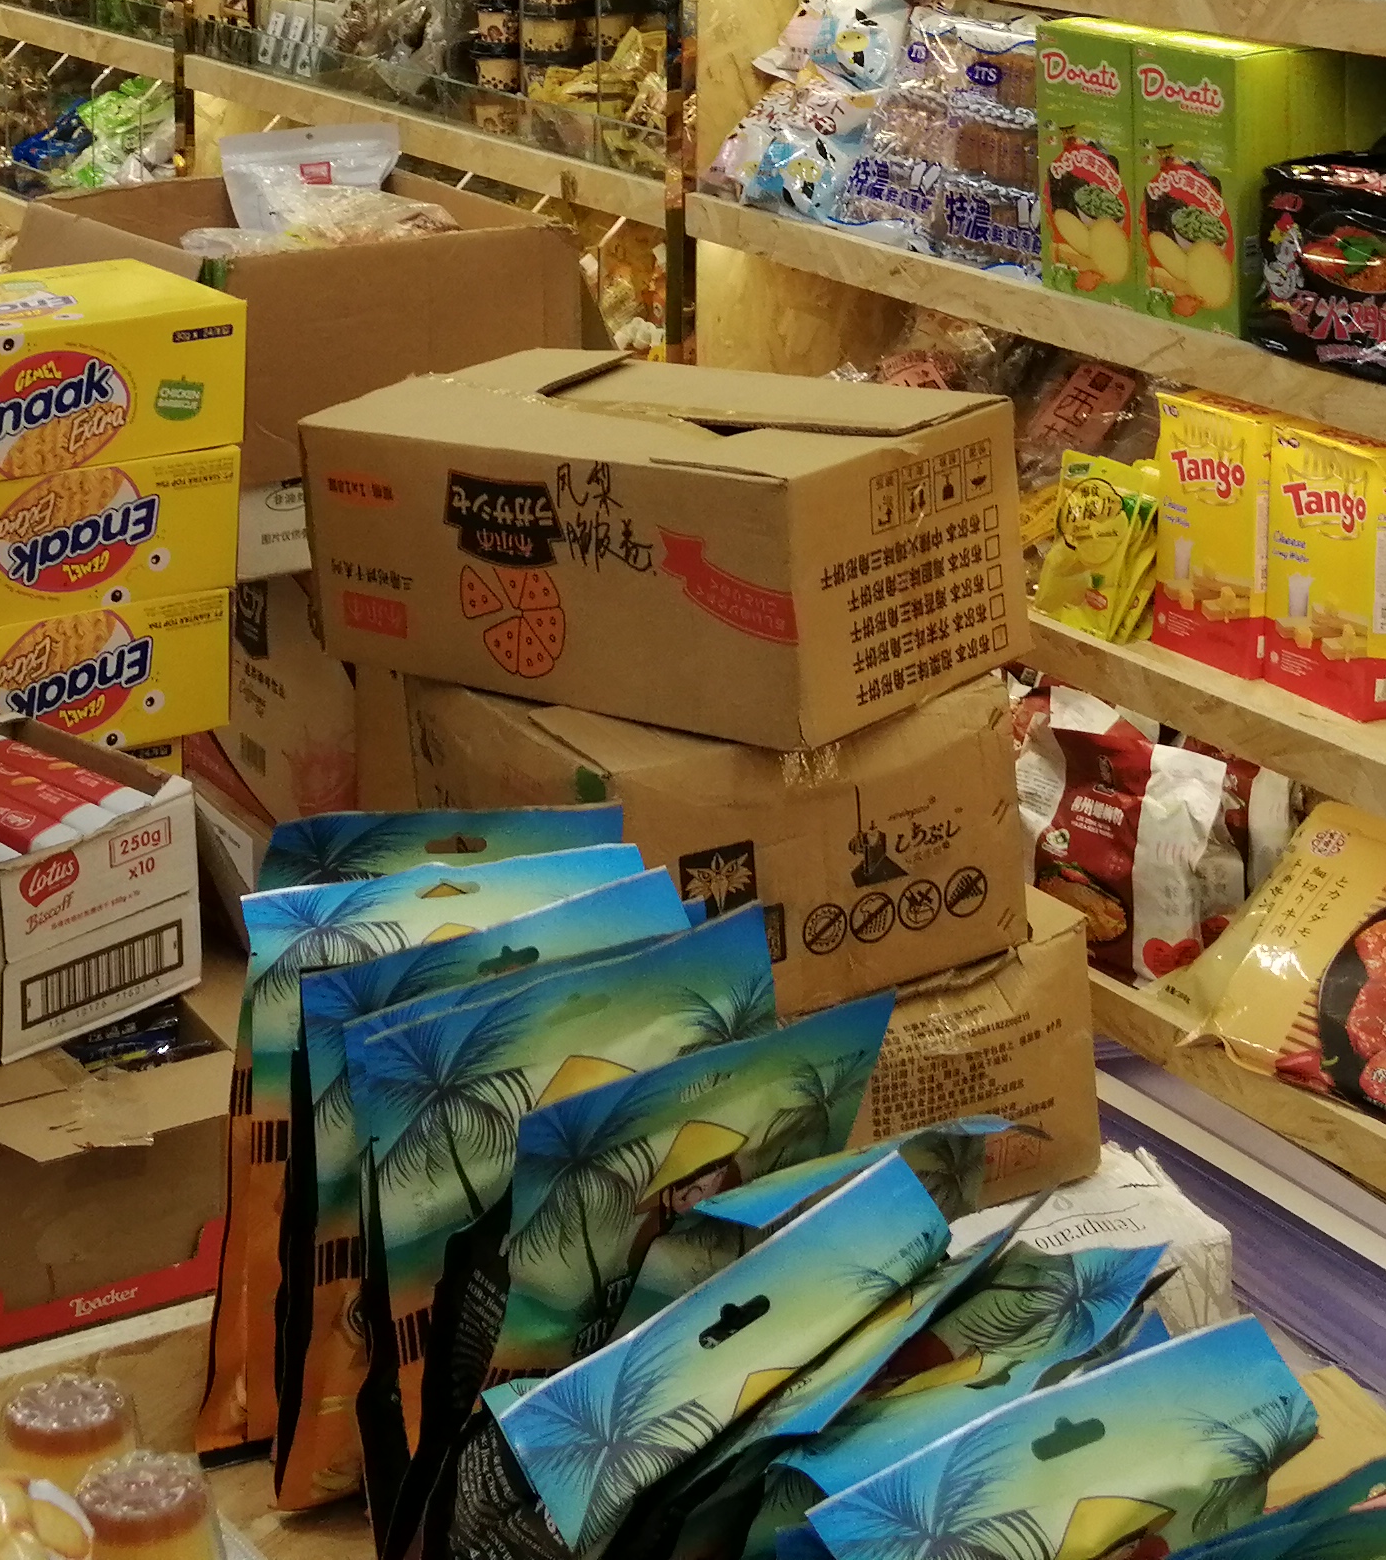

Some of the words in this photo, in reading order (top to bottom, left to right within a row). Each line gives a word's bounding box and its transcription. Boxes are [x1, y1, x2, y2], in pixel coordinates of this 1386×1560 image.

[1041, 47, 1122, 92] Dorati
[1138, 65, 1223, 111] Dorati
[14, 362, 62, 392] GEMEZ
[67, 406, 126, 453] Extra
[1170, 447, 1247, 500] Tango
[1282, 481, 1367, 535] Tango
[7, 493, 161, 586] Enaak
[62, 549, 110, 583] GEMEZ
[6, 635, 155, 719] Enaak
[59, 694, 106, 729] GEMEZ
[119, 829, 162, 856] 250g
[26, 855, 77, 900] Lotus
[127, 857, 156, 881] x10
[25, 891, 75, 936] Biscoff
[1034, 1216, 1147, 1250] Temprano
[69, 1287, 139, 1318] Loacker
